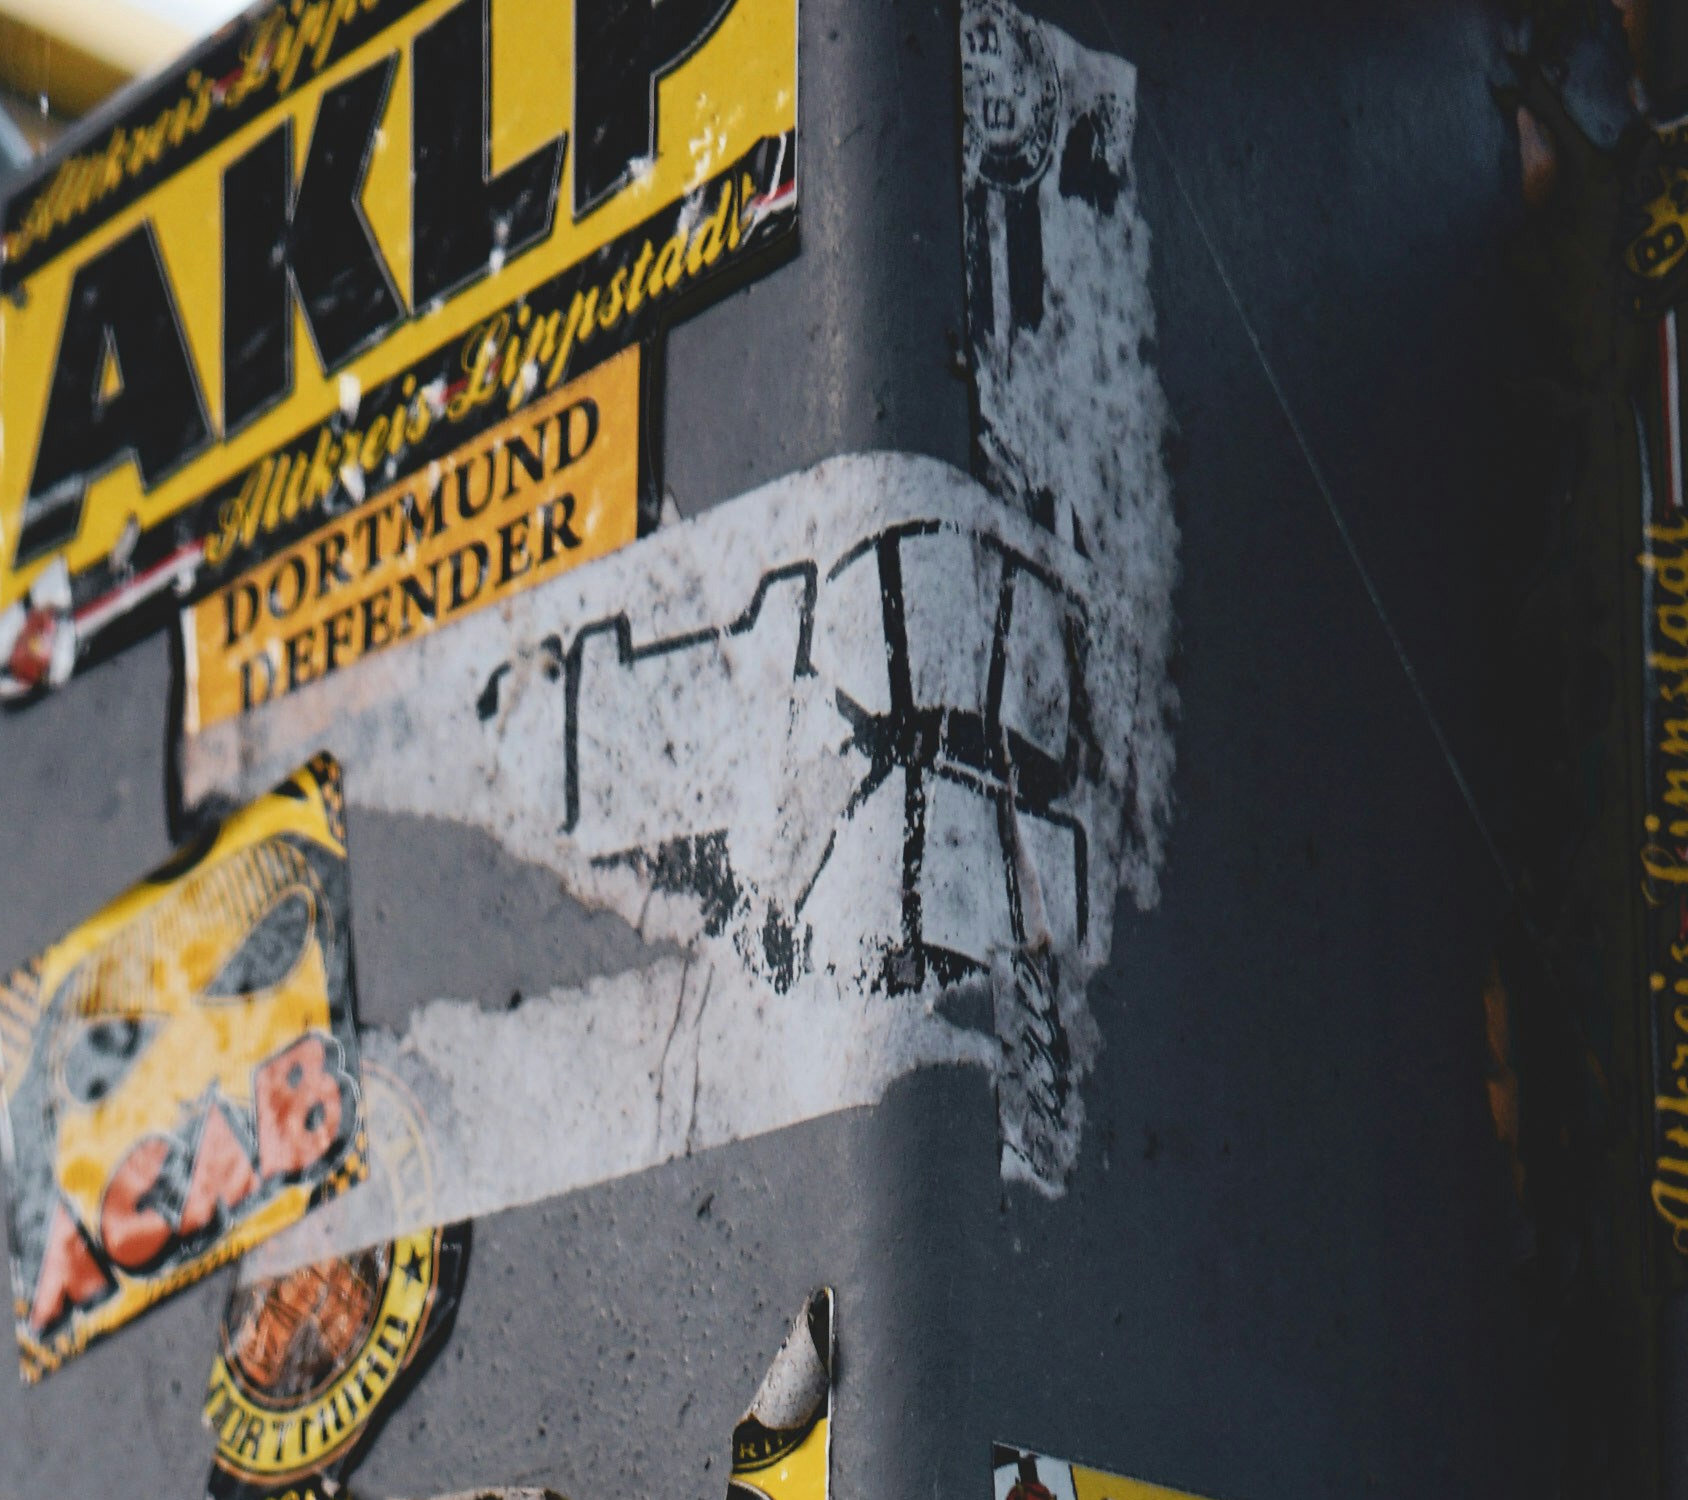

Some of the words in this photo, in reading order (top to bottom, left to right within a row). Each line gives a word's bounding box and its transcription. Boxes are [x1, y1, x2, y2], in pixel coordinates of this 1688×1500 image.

[14, 0, 727, 568] AKLP
[207, 375, 430, 563] Altkreis
[447, 172, 755, 421] Lippstadt
[223, 397, 600, 647] DORTMUND
[240, 492, 583, 712] DEFENDER
[29, 1037, 354, 1332] ACAB
